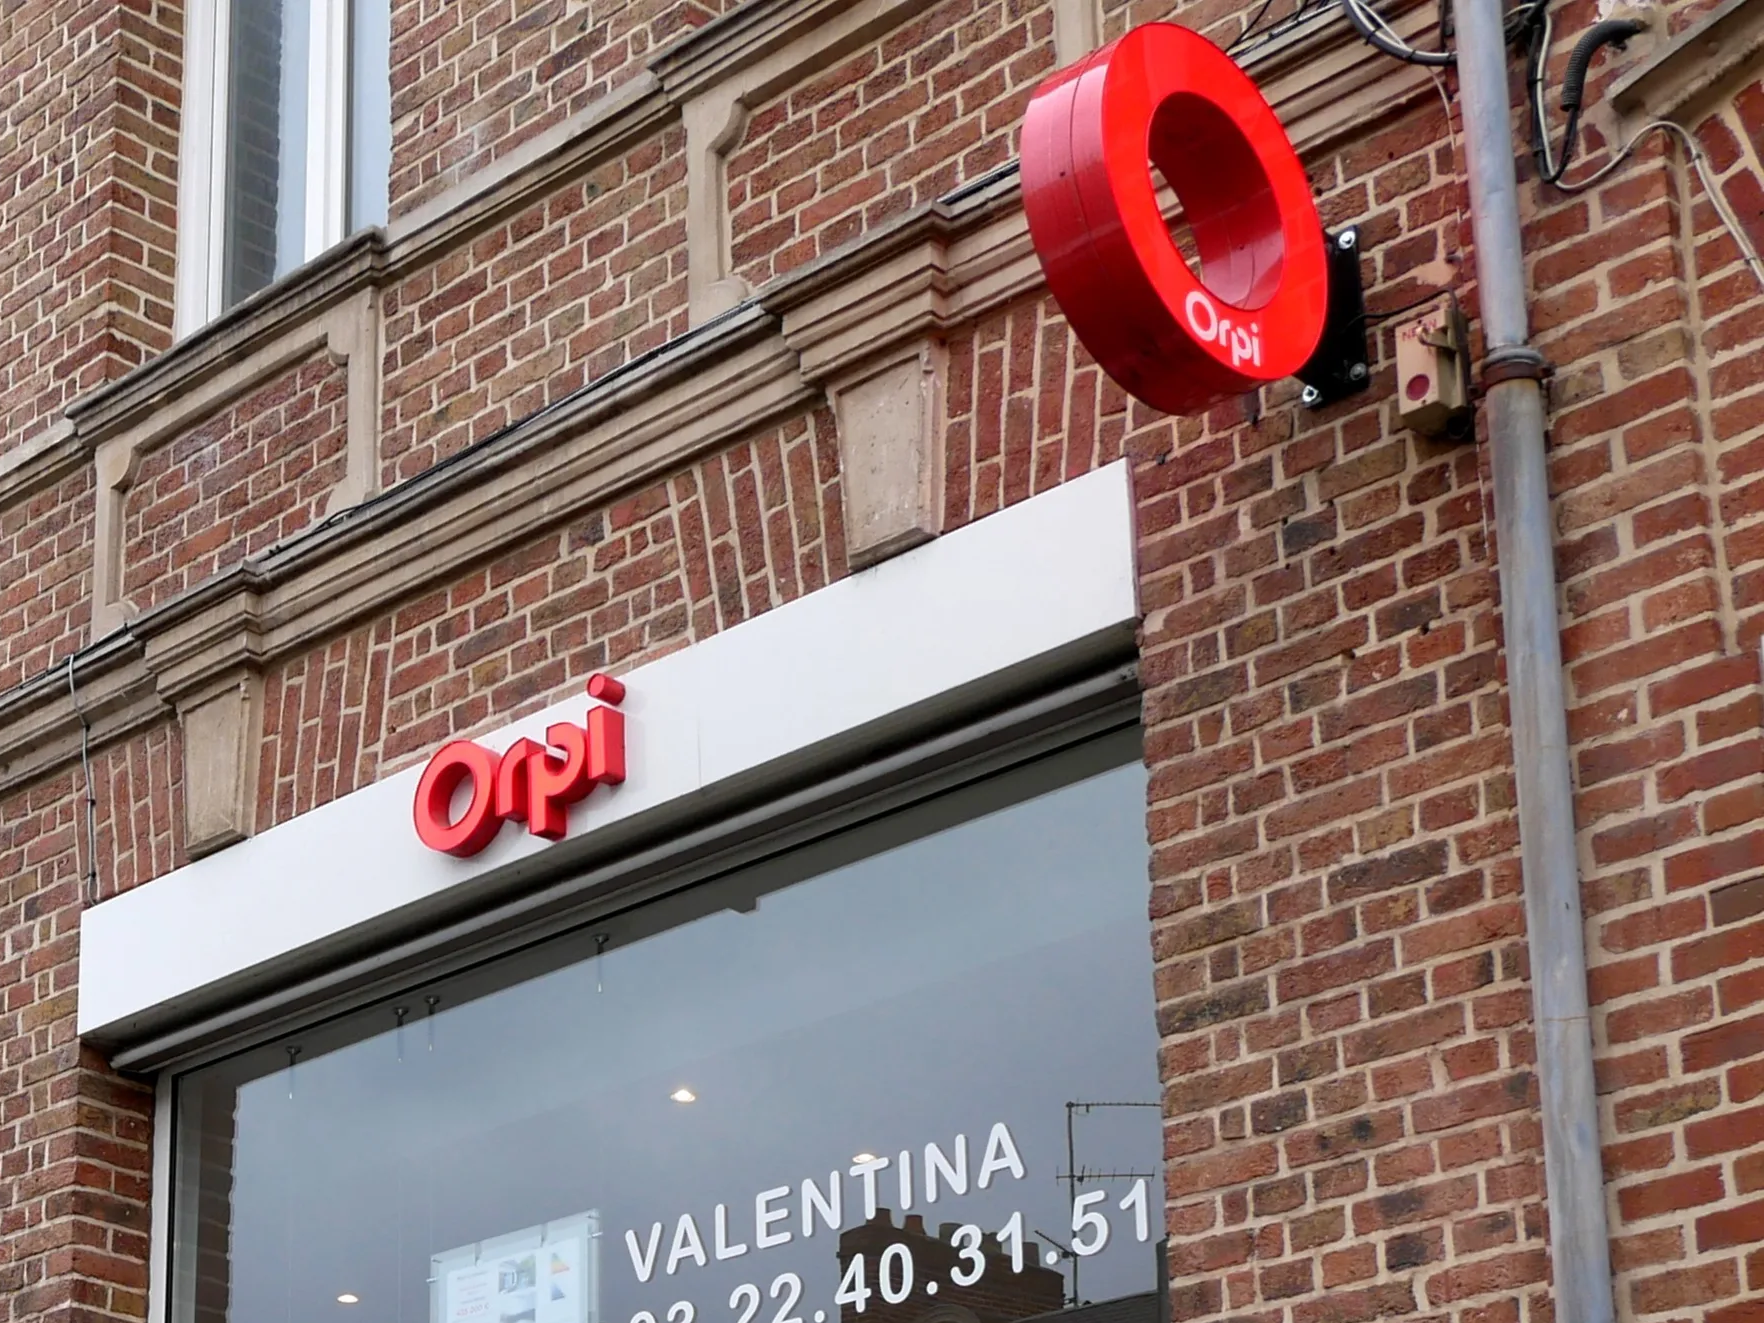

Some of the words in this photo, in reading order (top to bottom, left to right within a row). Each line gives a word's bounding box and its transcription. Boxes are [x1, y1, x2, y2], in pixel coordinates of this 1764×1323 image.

[1185, 290, 1262, 368] Orpi
[413, 673, 626, 858] Orpi
[624, 1121, 1026, 1284] VALENTINA
